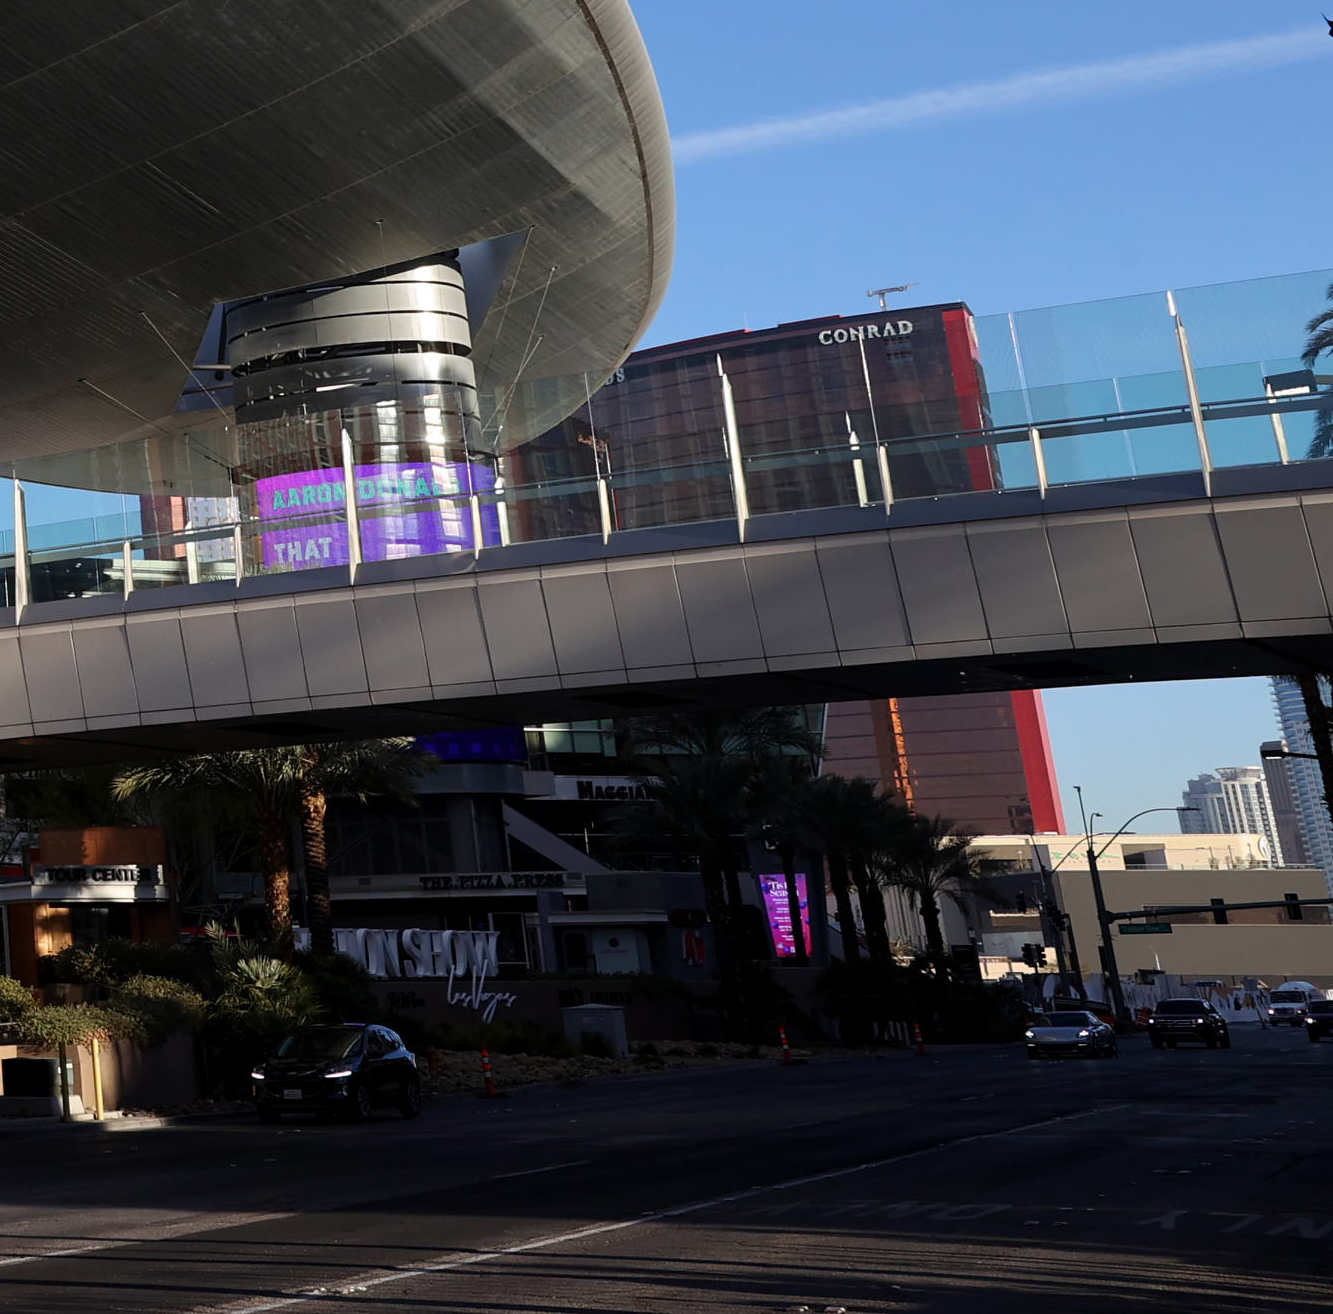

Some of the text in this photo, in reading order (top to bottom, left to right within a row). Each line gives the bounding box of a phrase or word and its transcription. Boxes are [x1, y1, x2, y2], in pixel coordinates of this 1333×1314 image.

[818, 321, 913, 346] CONRAD
[273, 481, 347, 512] AARON
[274, 537, 334, 565] THAT
[46, 868, 151, 882] TOUR CENTER
[420, 876, 452, 890] THE
[402, 928, 501, 979] SHOW
